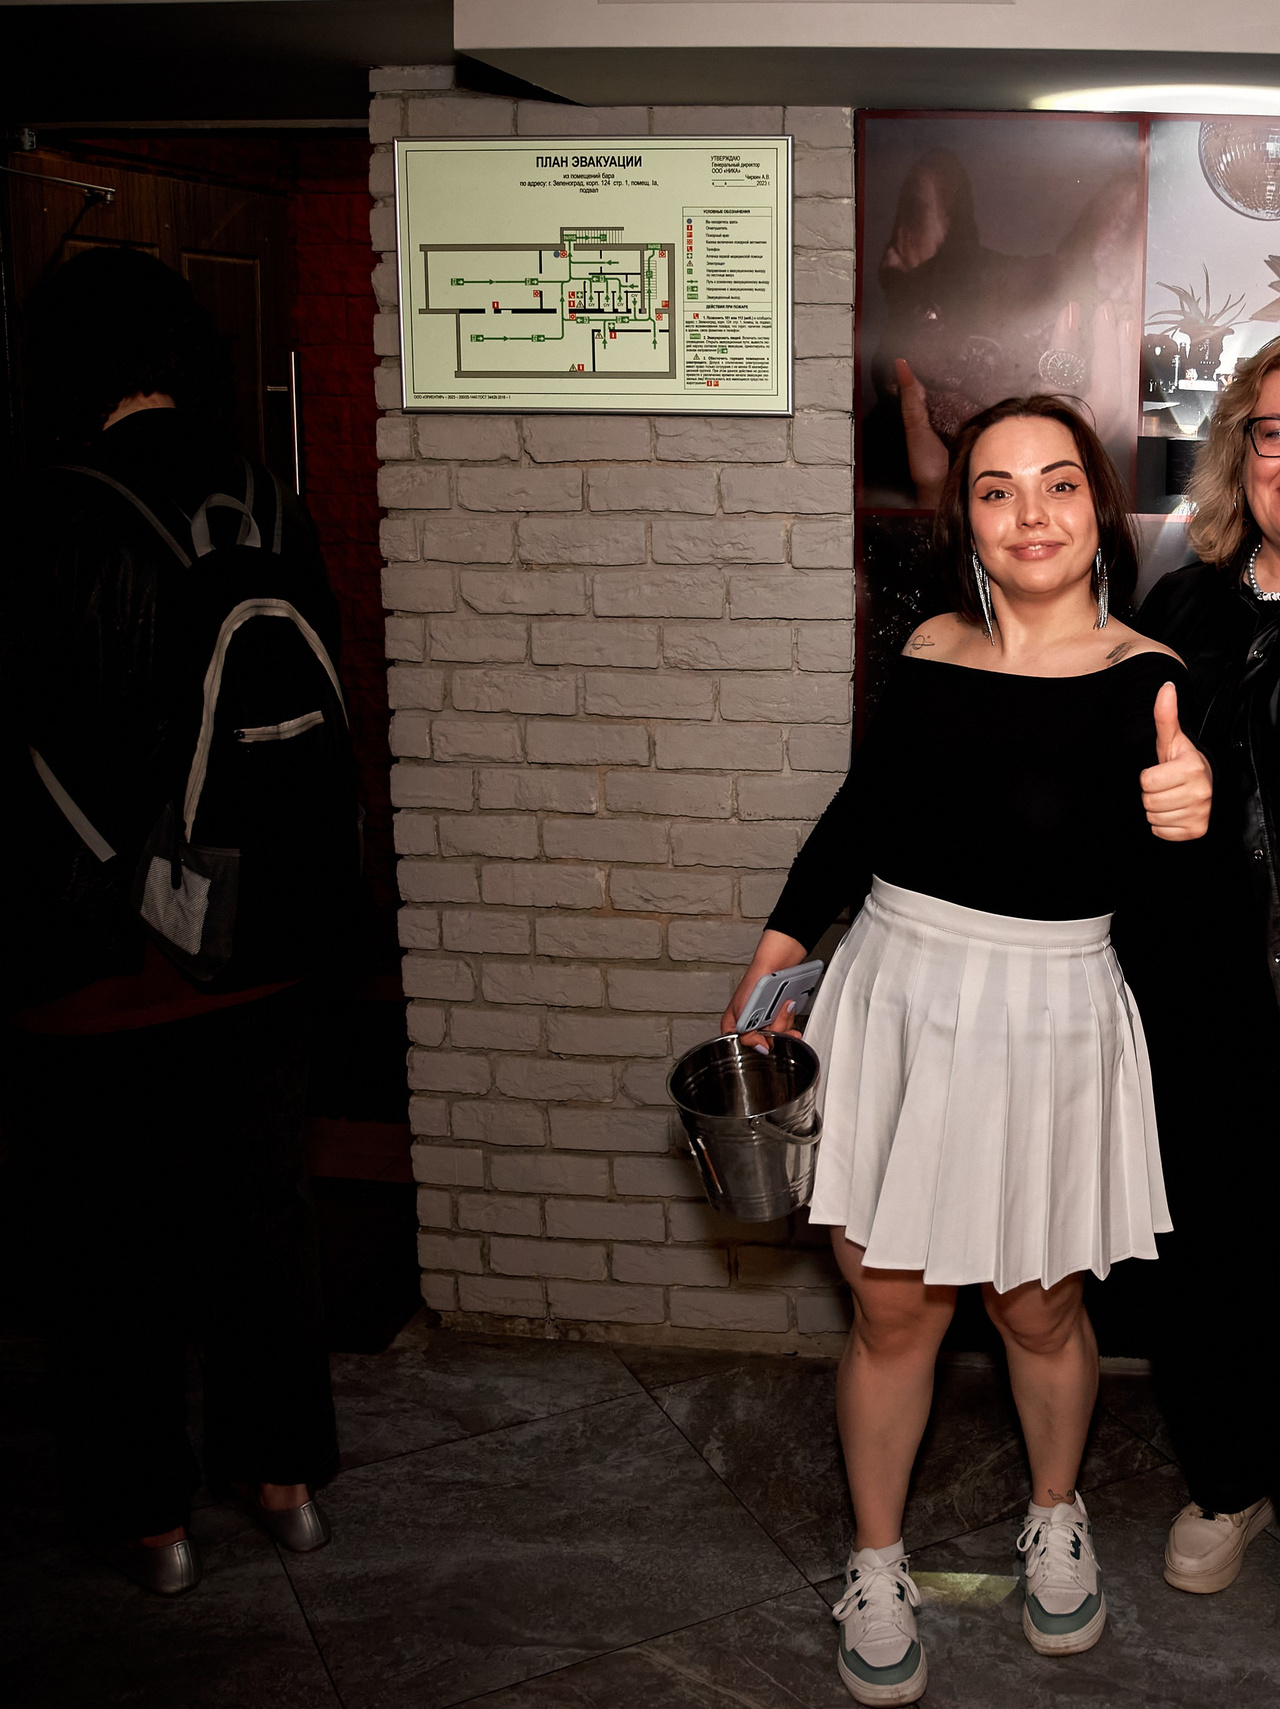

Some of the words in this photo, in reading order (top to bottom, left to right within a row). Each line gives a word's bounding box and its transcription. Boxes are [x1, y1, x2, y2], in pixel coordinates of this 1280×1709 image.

[536, 156, 568, 168] ПЛАН
[571, 155, 642, 169] ЭВАКУАЦИИ
[571, 172, 601, 180] помещений
[602, 172, 615, 180] бара
